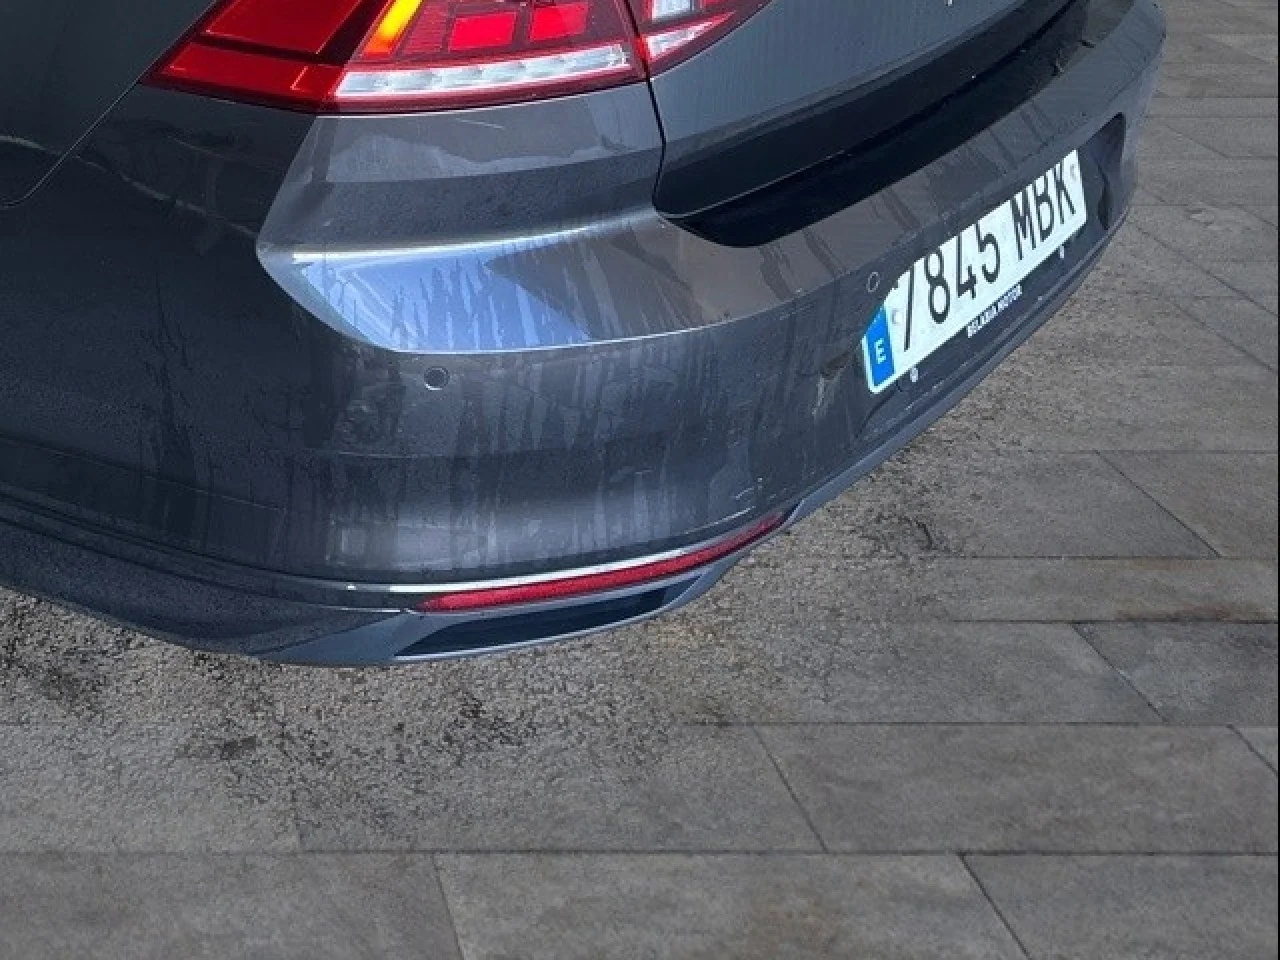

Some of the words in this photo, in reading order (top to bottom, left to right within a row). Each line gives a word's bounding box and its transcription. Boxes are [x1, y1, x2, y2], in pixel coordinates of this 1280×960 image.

[874, 339, 887, 365] E
[894, 222, 1001, 353] 7845
[1009, 157, 1076, 261] MBK
